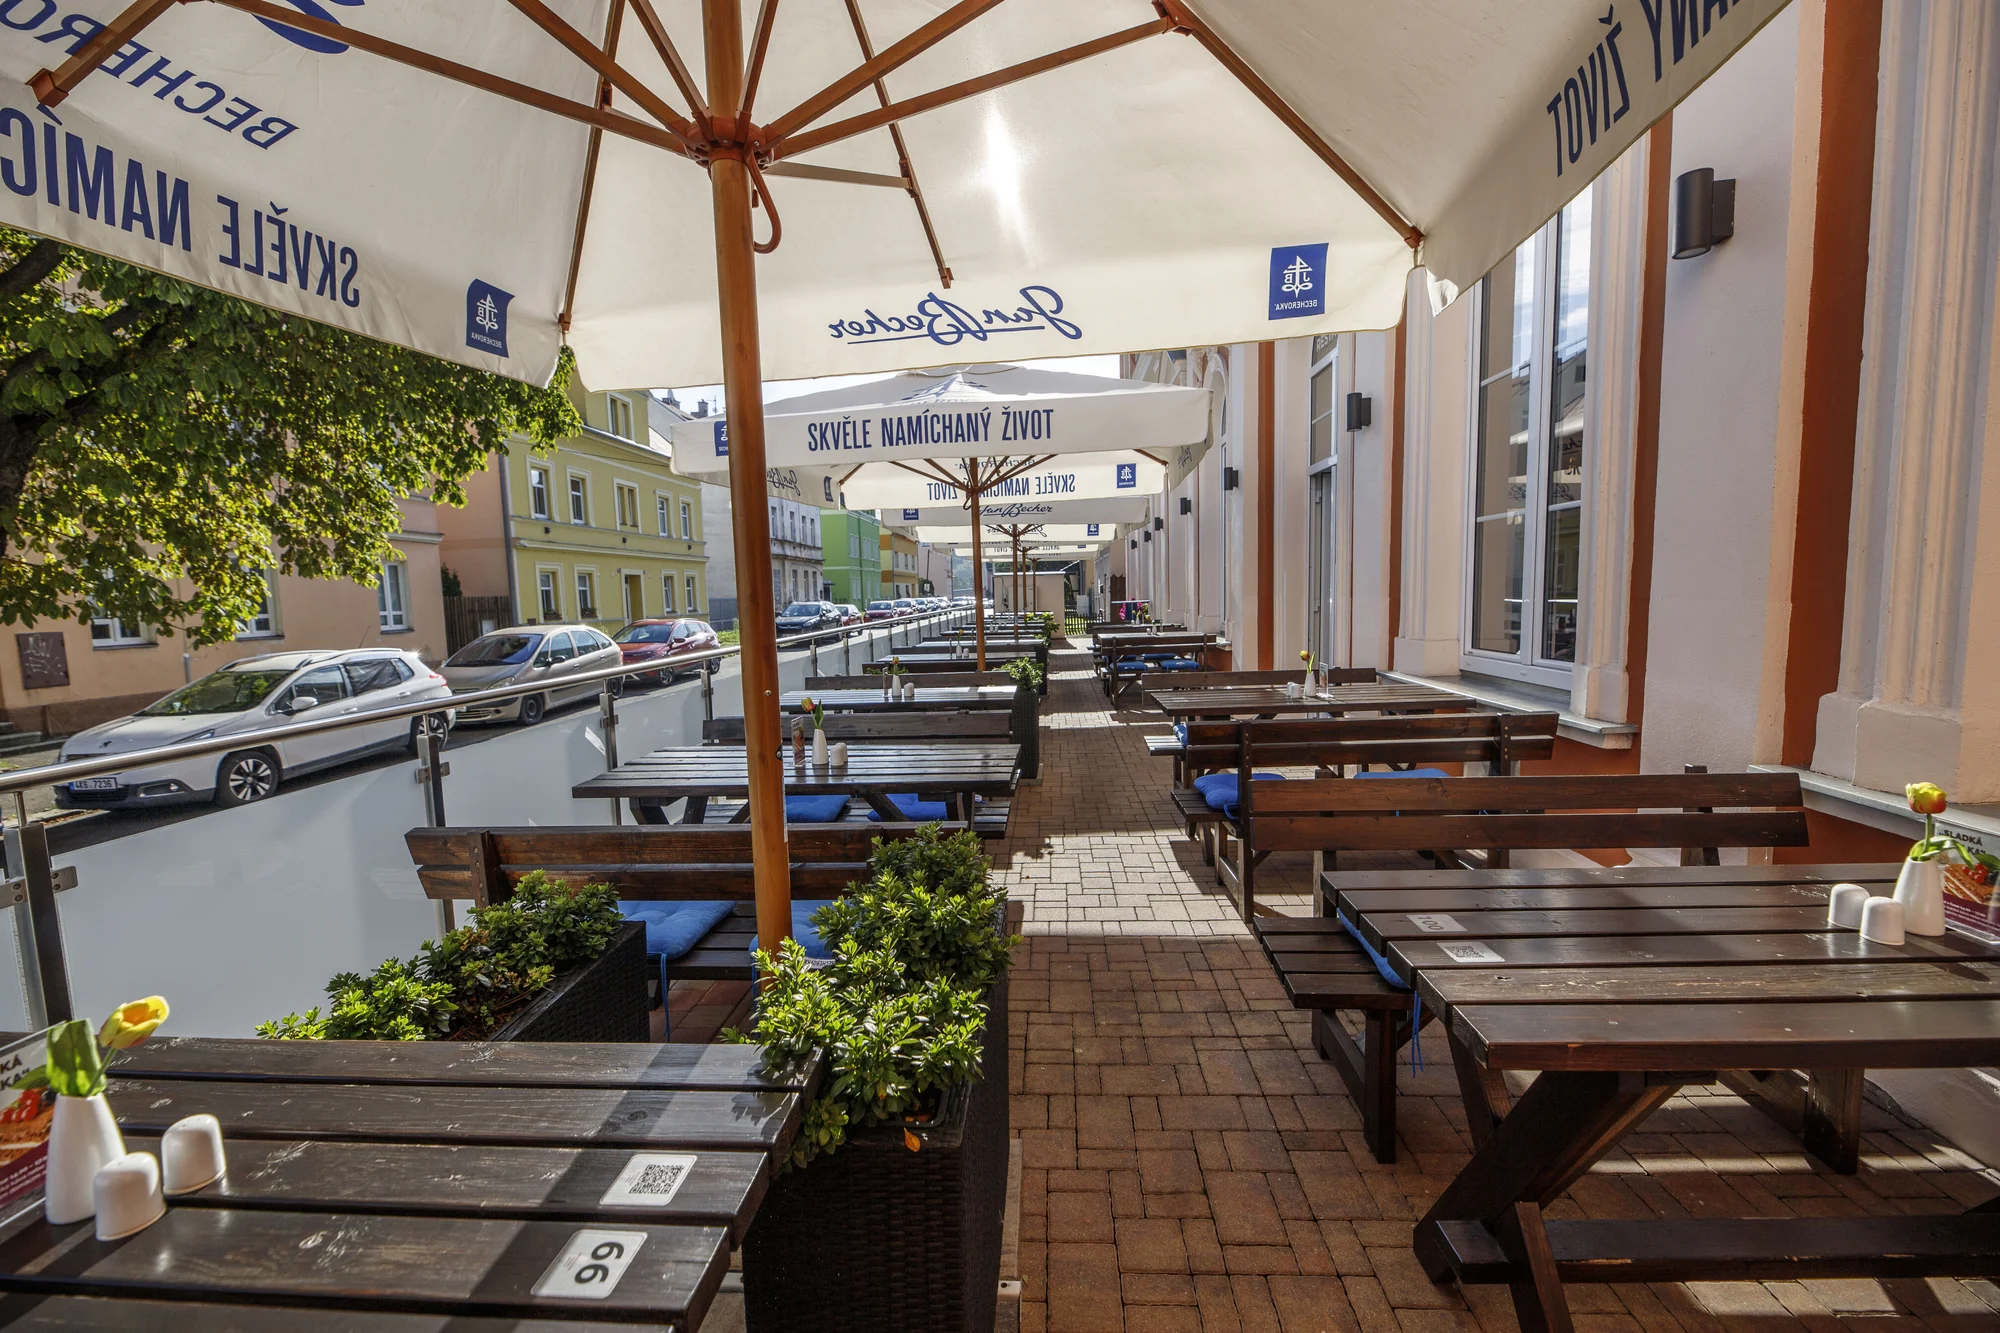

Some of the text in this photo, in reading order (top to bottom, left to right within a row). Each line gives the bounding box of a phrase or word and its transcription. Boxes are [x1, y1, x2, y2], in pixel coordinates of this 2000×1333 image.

[808, 405, 1054, 452] SKVĚLE NAMÍCHANÝ ŽIVOT
[1001, 503, 1053, 517] Becher
[1417, 916, 1444, 930] 100
